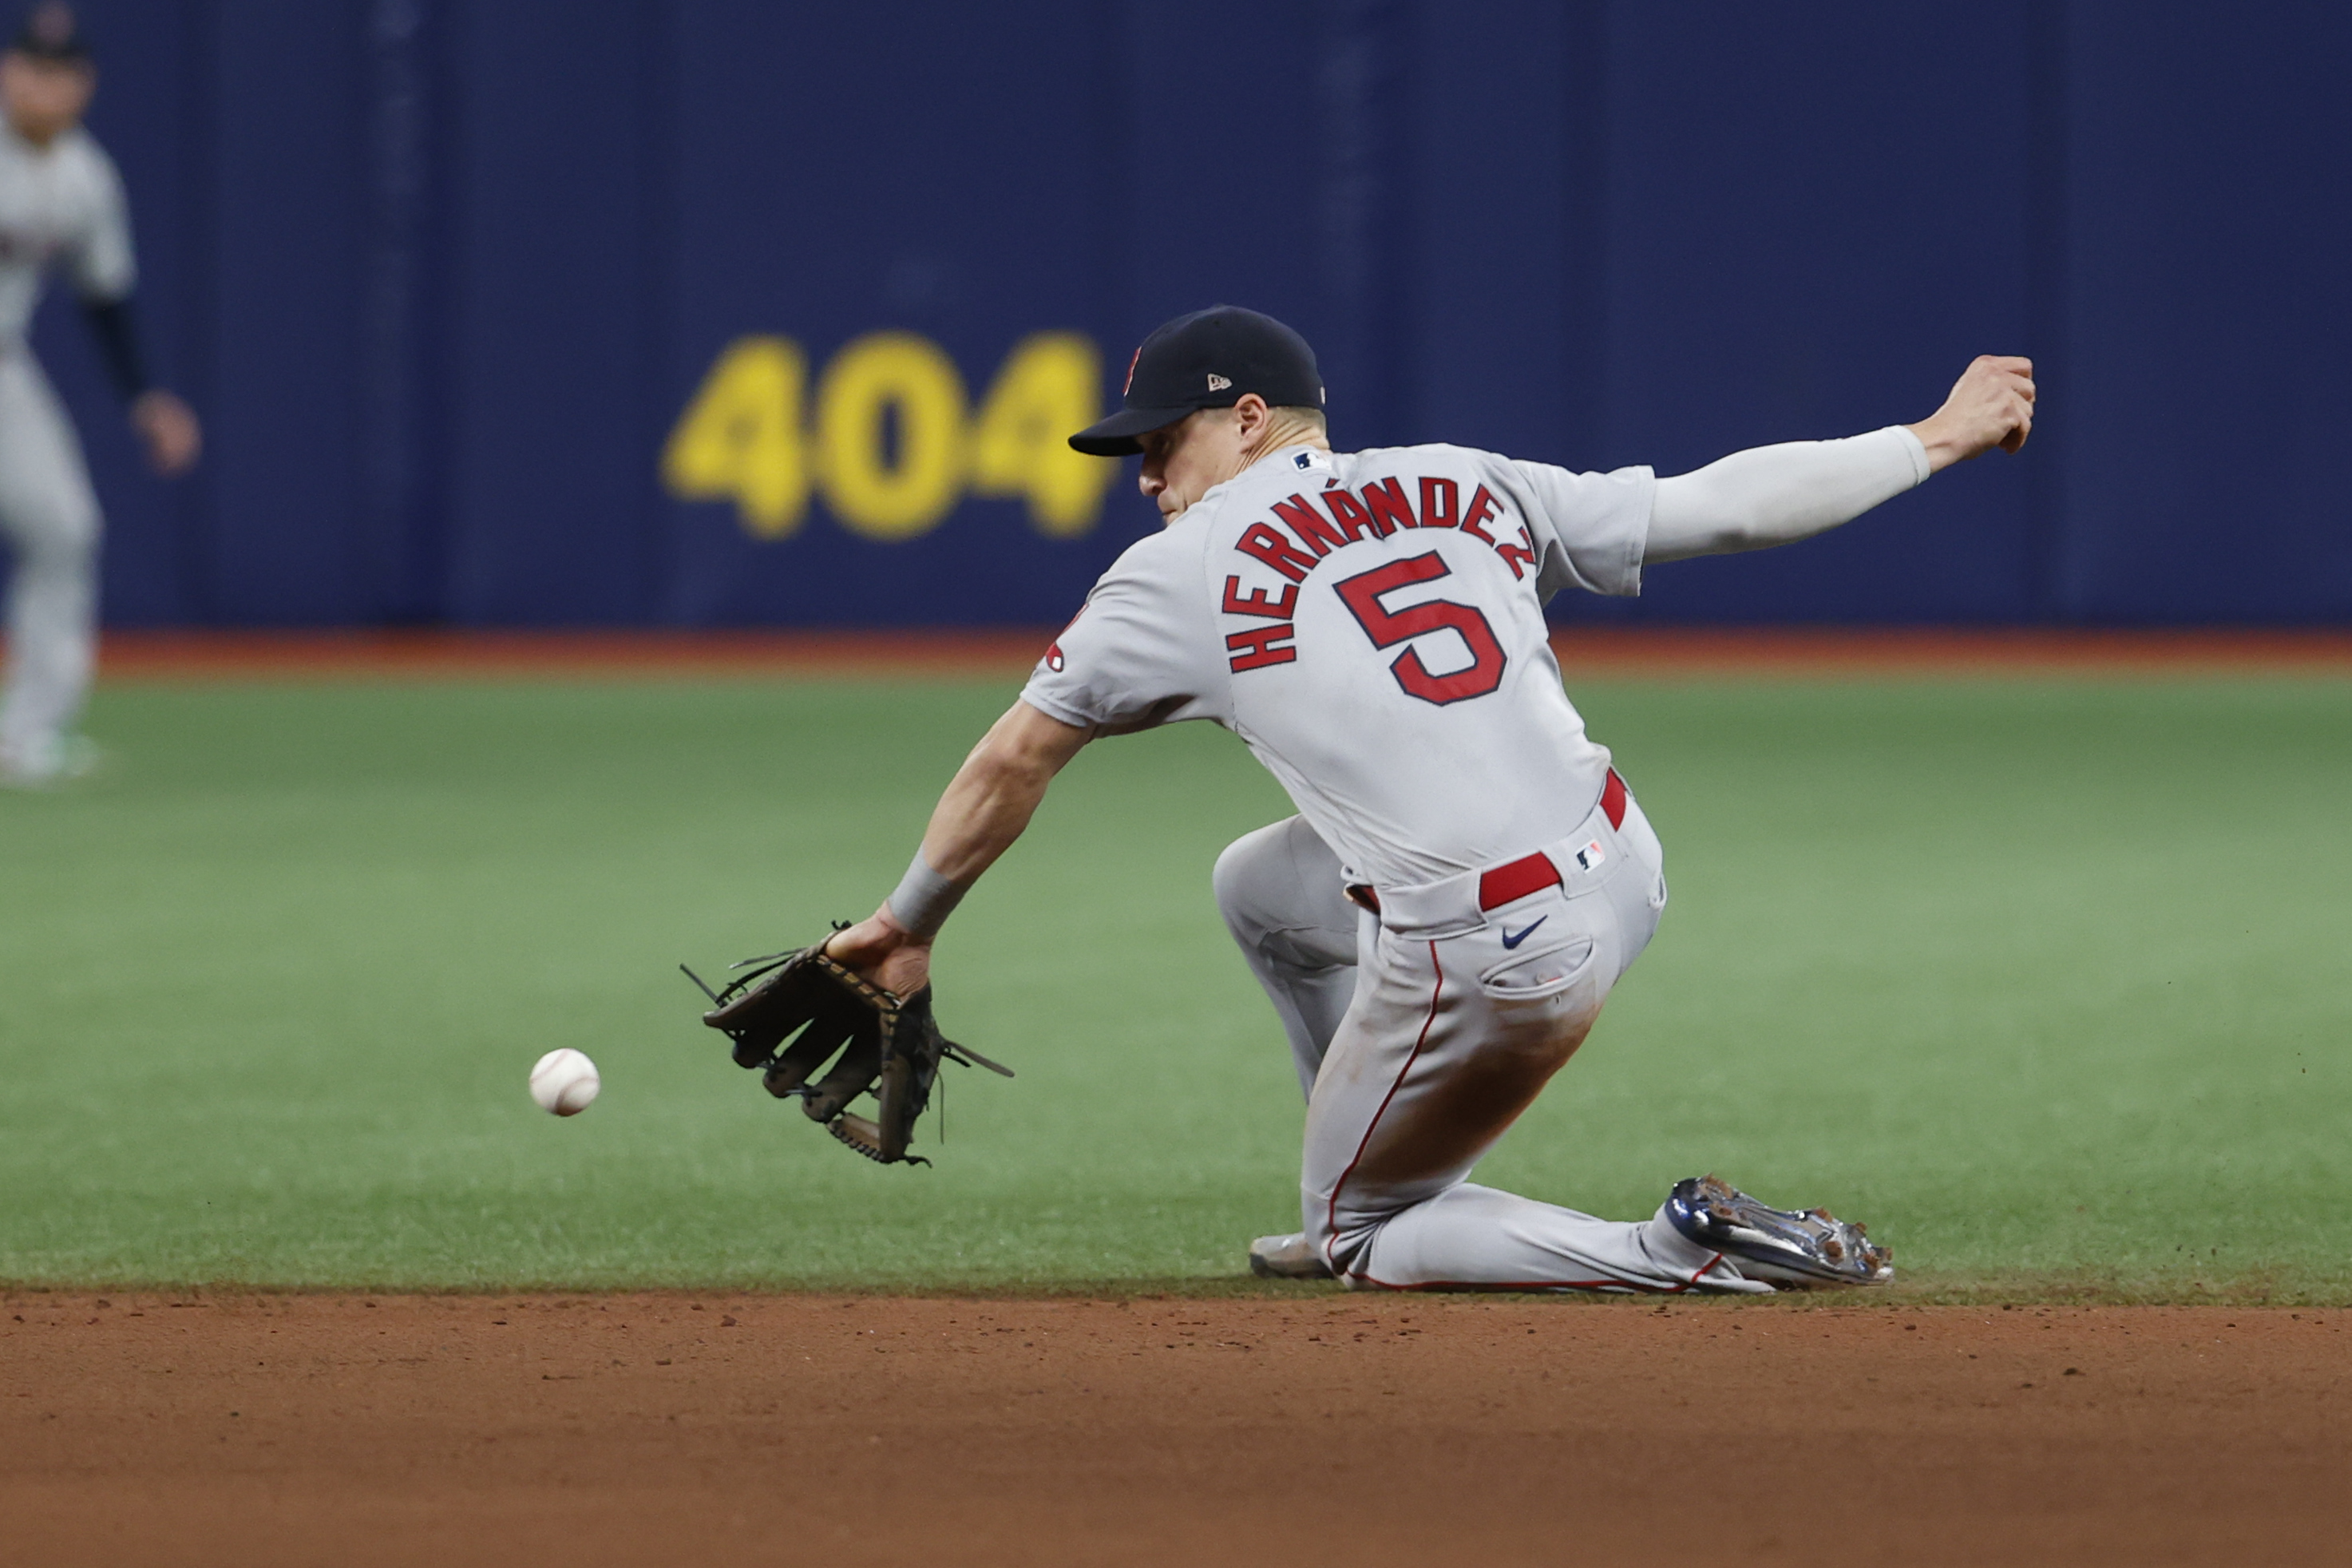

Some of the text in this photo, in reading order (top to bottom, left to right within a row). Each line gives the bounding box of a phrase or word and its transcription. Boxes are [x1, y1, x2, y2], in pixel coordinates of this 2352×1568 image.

[661, 329, 1115, 540] 404
[1222, 476, 1536, 674] HERNÁNDEZ
[1332, 548, 1507, 707] 5
